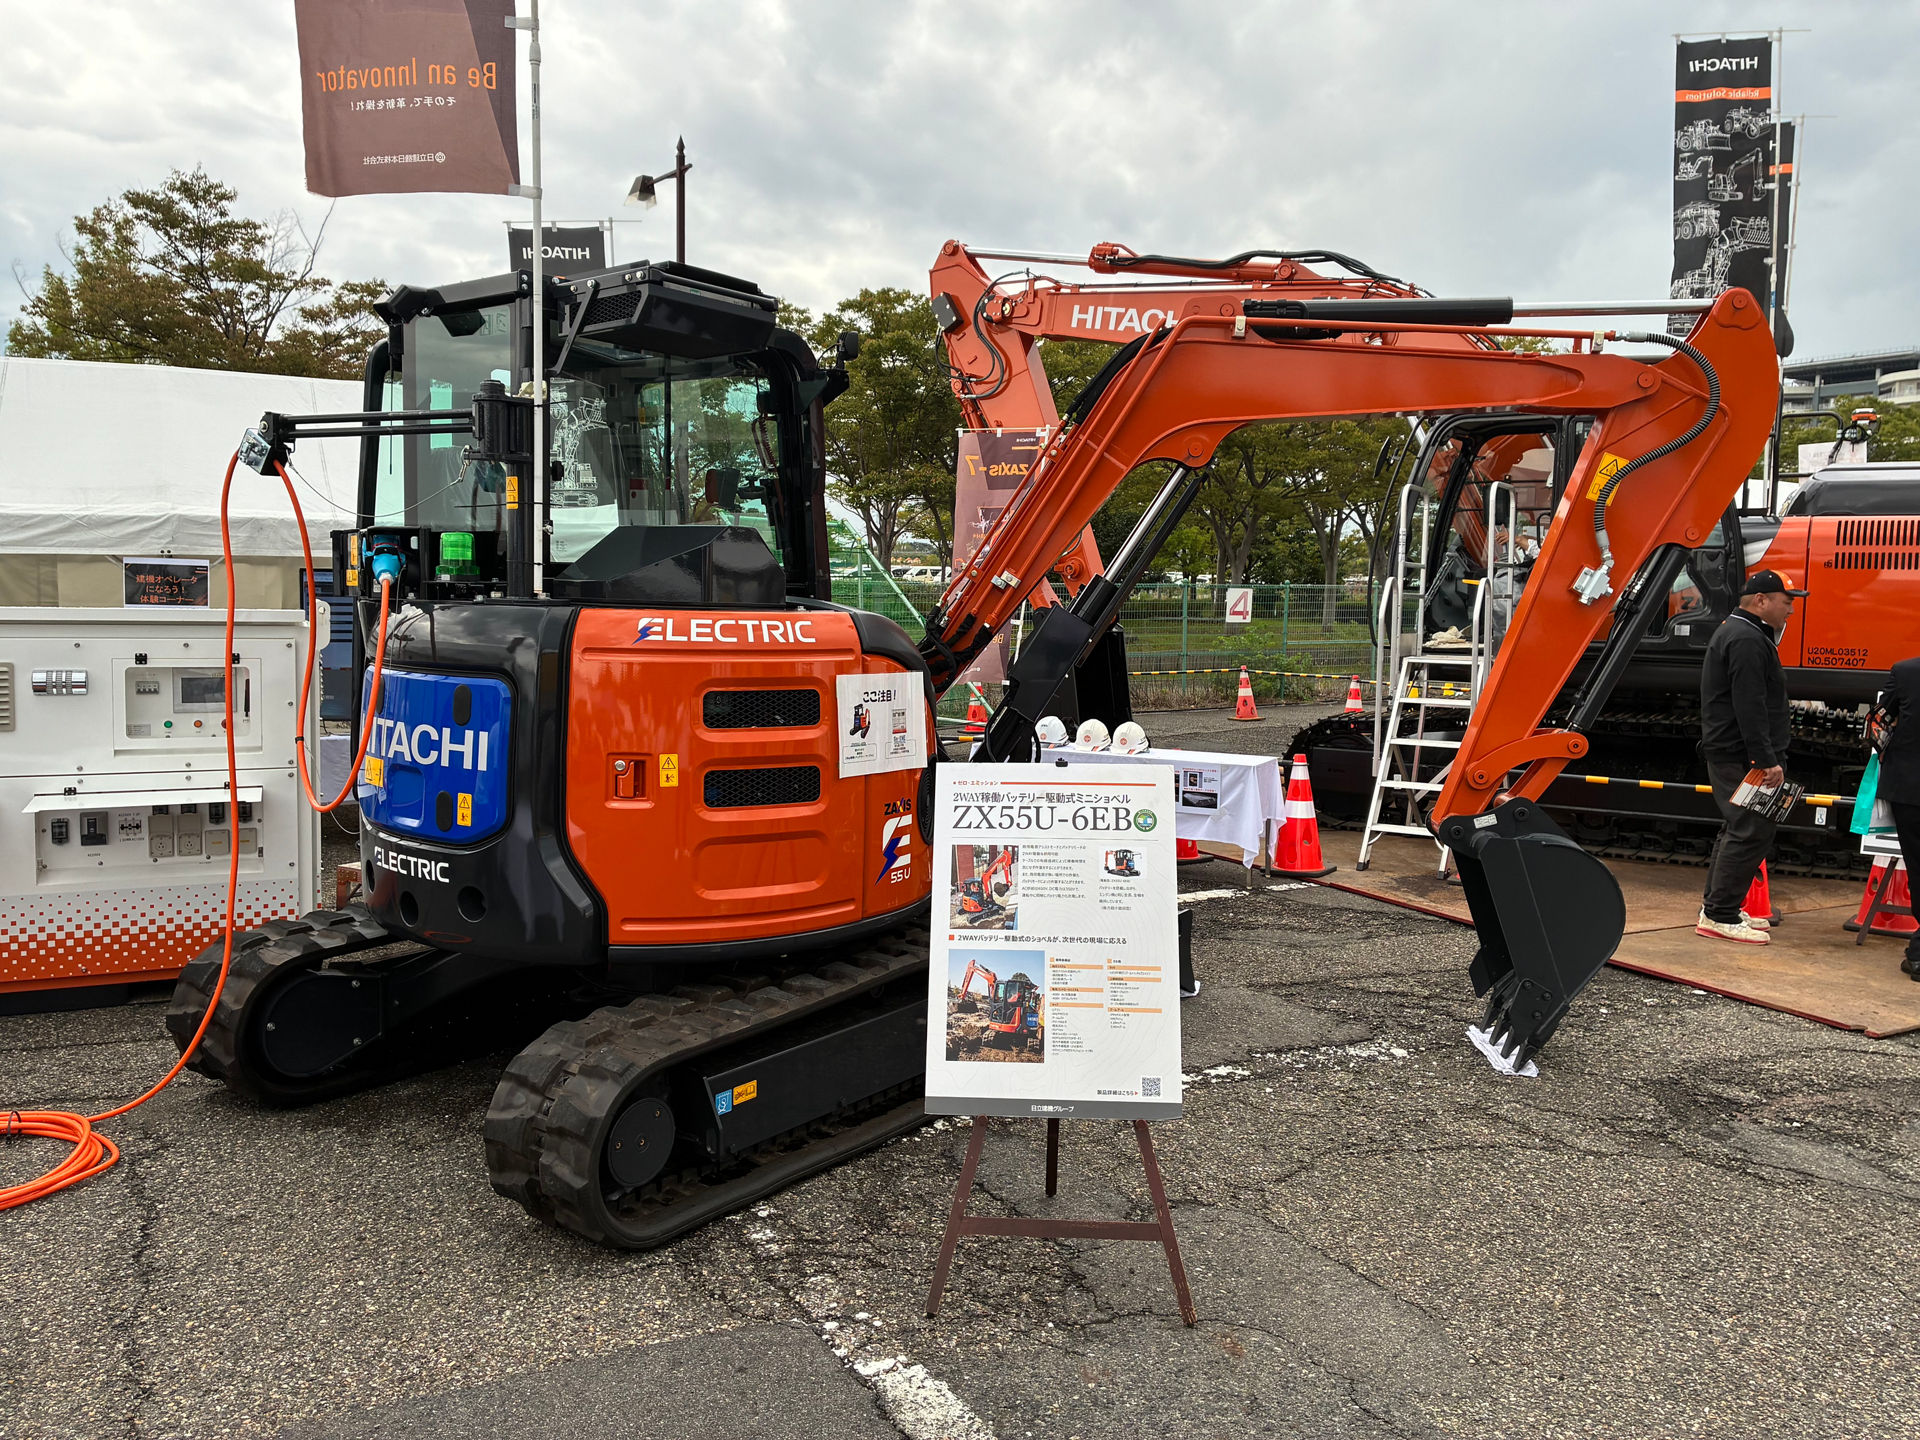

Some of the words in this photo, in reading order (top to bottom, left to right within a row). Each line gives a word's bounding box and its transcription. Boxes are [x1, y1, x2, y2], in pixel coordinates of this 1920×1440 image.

[1070, 304, 1179, 333] HITACH
[1229, 591, 1250, 620] 4
[635, 617, 816, 643] ELECTRIC
[1807, 656, 1867, 667] NO.507407
[863, 689, 897, 703] ここ注目！
[884, 798, 912, 816] ZAXIS
[952, 805, 1133, 831] ZX55U-6EB
[374, 846, 450, 883] ELECTRIC
